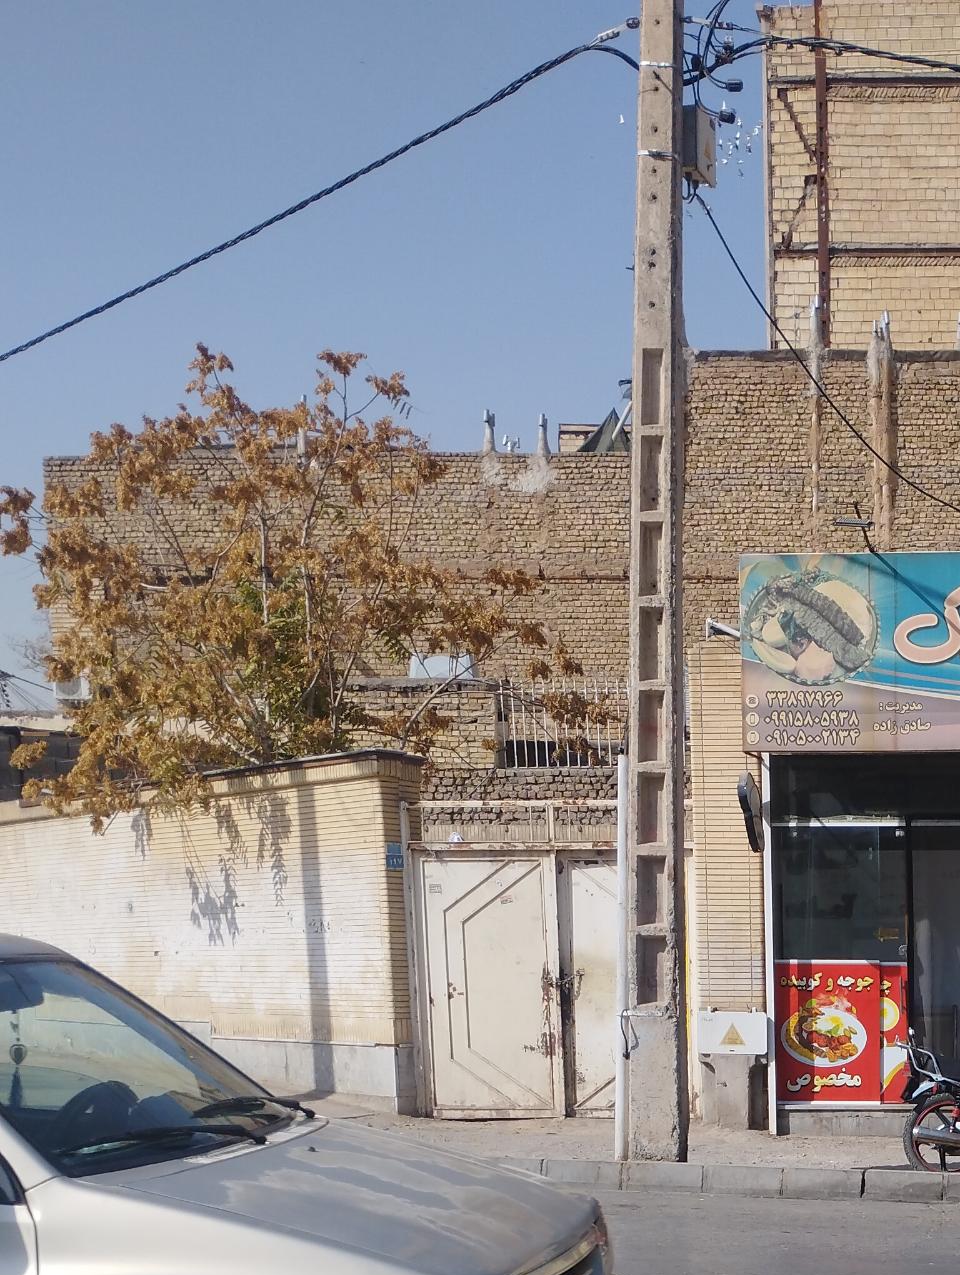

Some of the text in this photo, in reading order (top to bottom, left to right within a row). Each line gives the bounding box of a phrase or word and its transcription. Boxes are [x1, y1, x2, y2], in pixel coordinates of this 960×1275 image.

[872, 718, 932, 735] صادق زاده
[780, 972, 823, 992] کوبیده
[825, 978, 834, 991] و
[836, 975, 874, 992] جوجه
[786, 1067, 862, 1092] مخصوص
